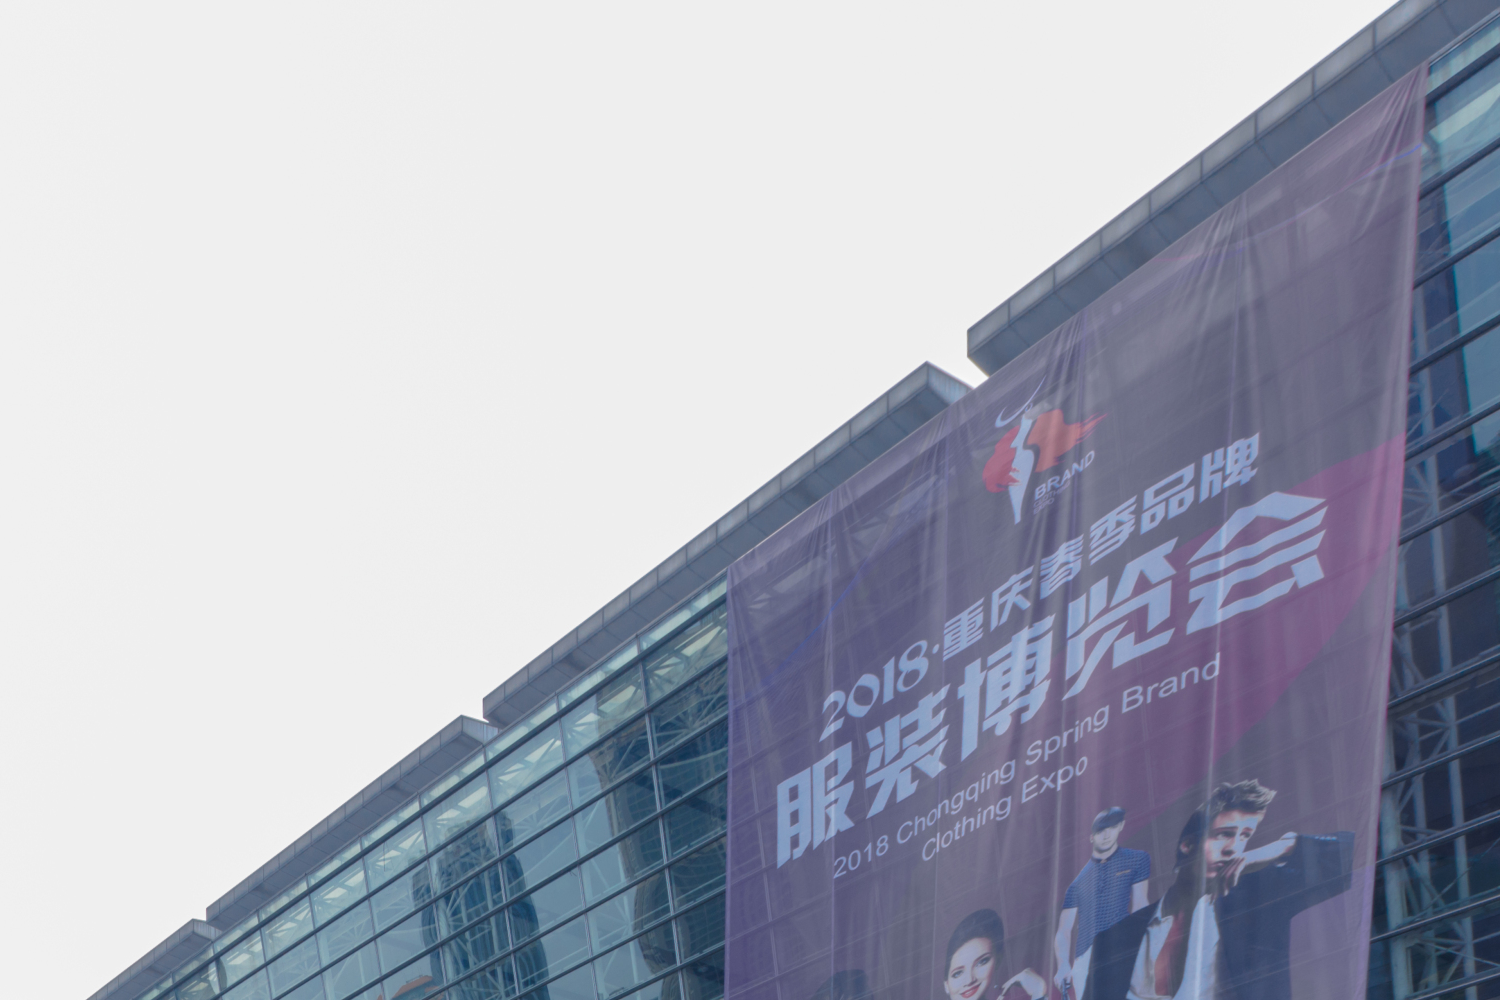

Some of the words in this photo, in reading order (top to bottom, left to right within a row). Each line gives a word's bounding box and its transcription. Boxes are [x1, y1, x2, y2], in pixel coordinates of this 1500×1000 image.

[1034, 450, 1096, 501] BRAND
[776, 490, 1329, 869] 服装博览会
[833, 835, 889, 879] 2018
[896, 758, 1016, 844] Chongqing
[1025, 705, 1109, 766] Spring
[1121, 652, 1221, 714] Brand
[921, 796, 1012, 862] Clothing
[1021, 756, 1089, 804] Expo
